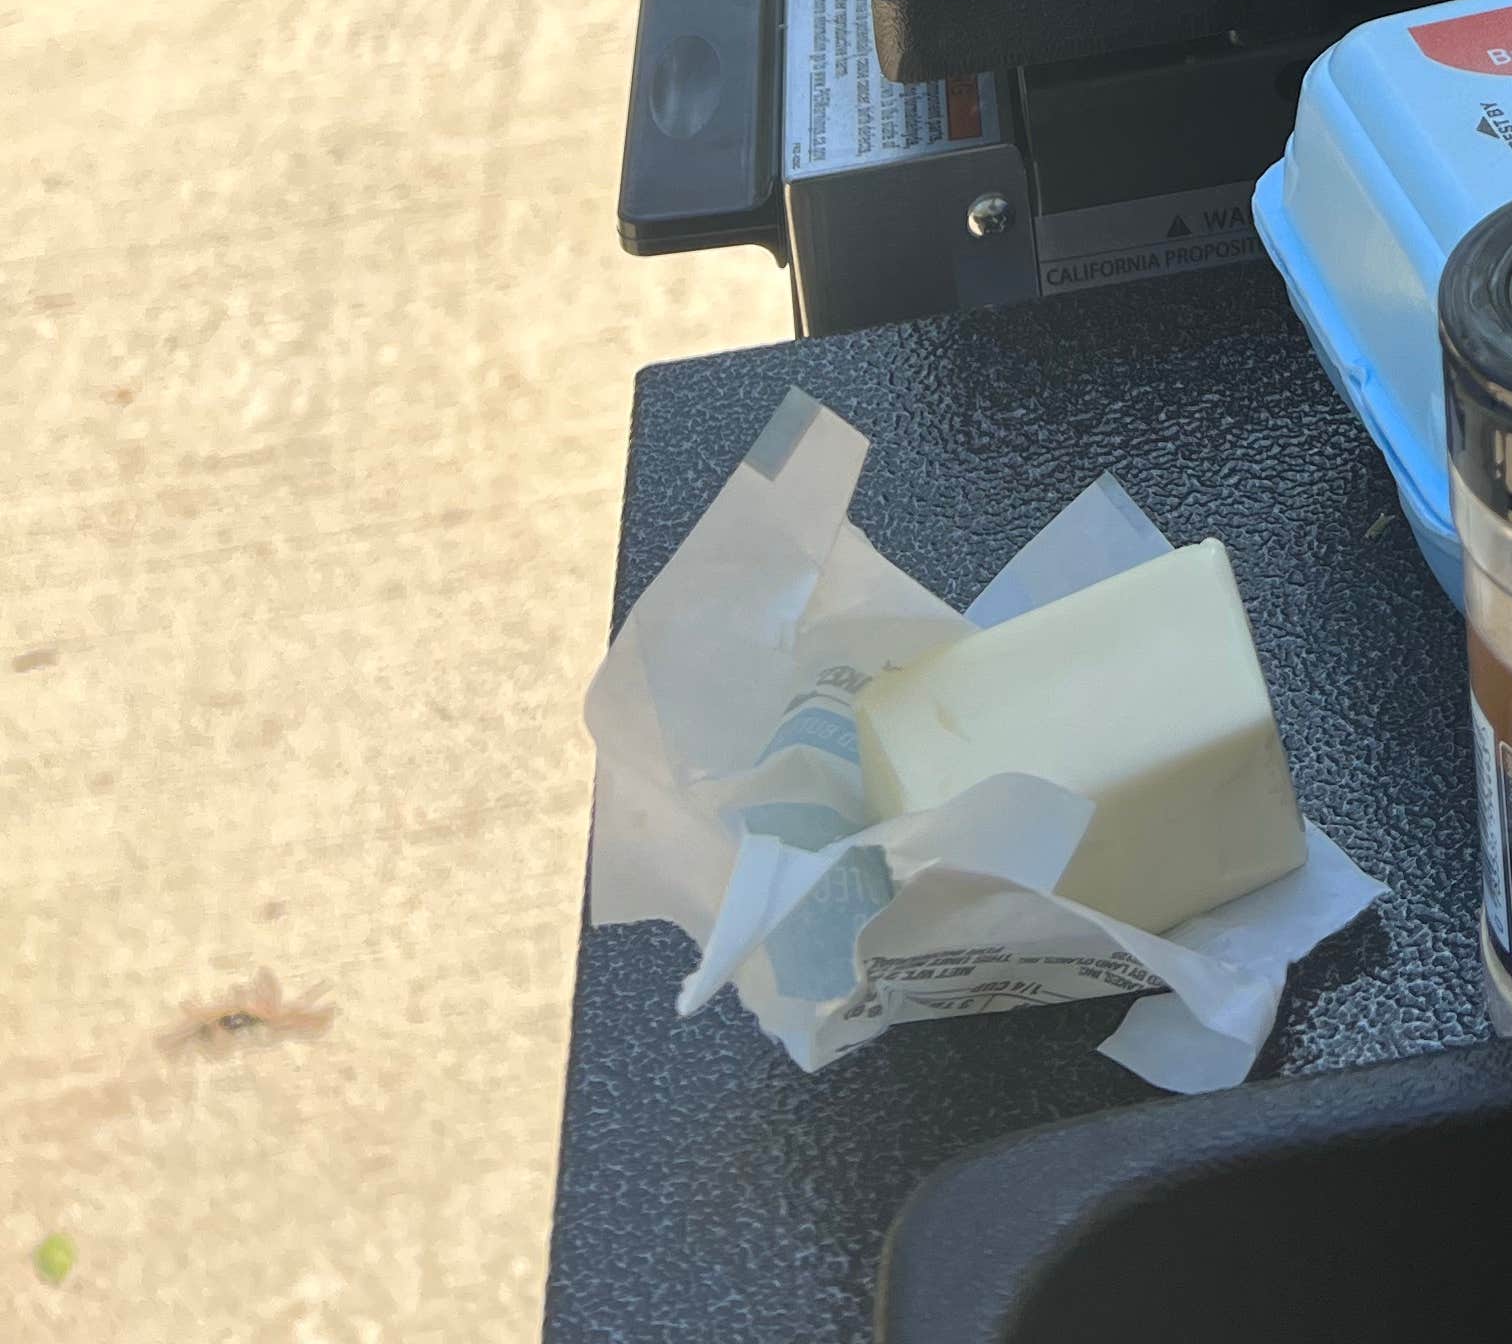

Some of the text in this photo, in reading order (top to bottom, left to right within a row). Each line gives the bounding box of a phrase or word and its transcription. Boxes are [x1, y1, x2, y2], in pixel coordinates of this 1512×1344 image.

[1479, 102, 1504, 118] BY
[1046, 235, 1261, 286] CALIFORNIA PROPOSIT
[970, 981, 1042, 996] 1/4 CUP
